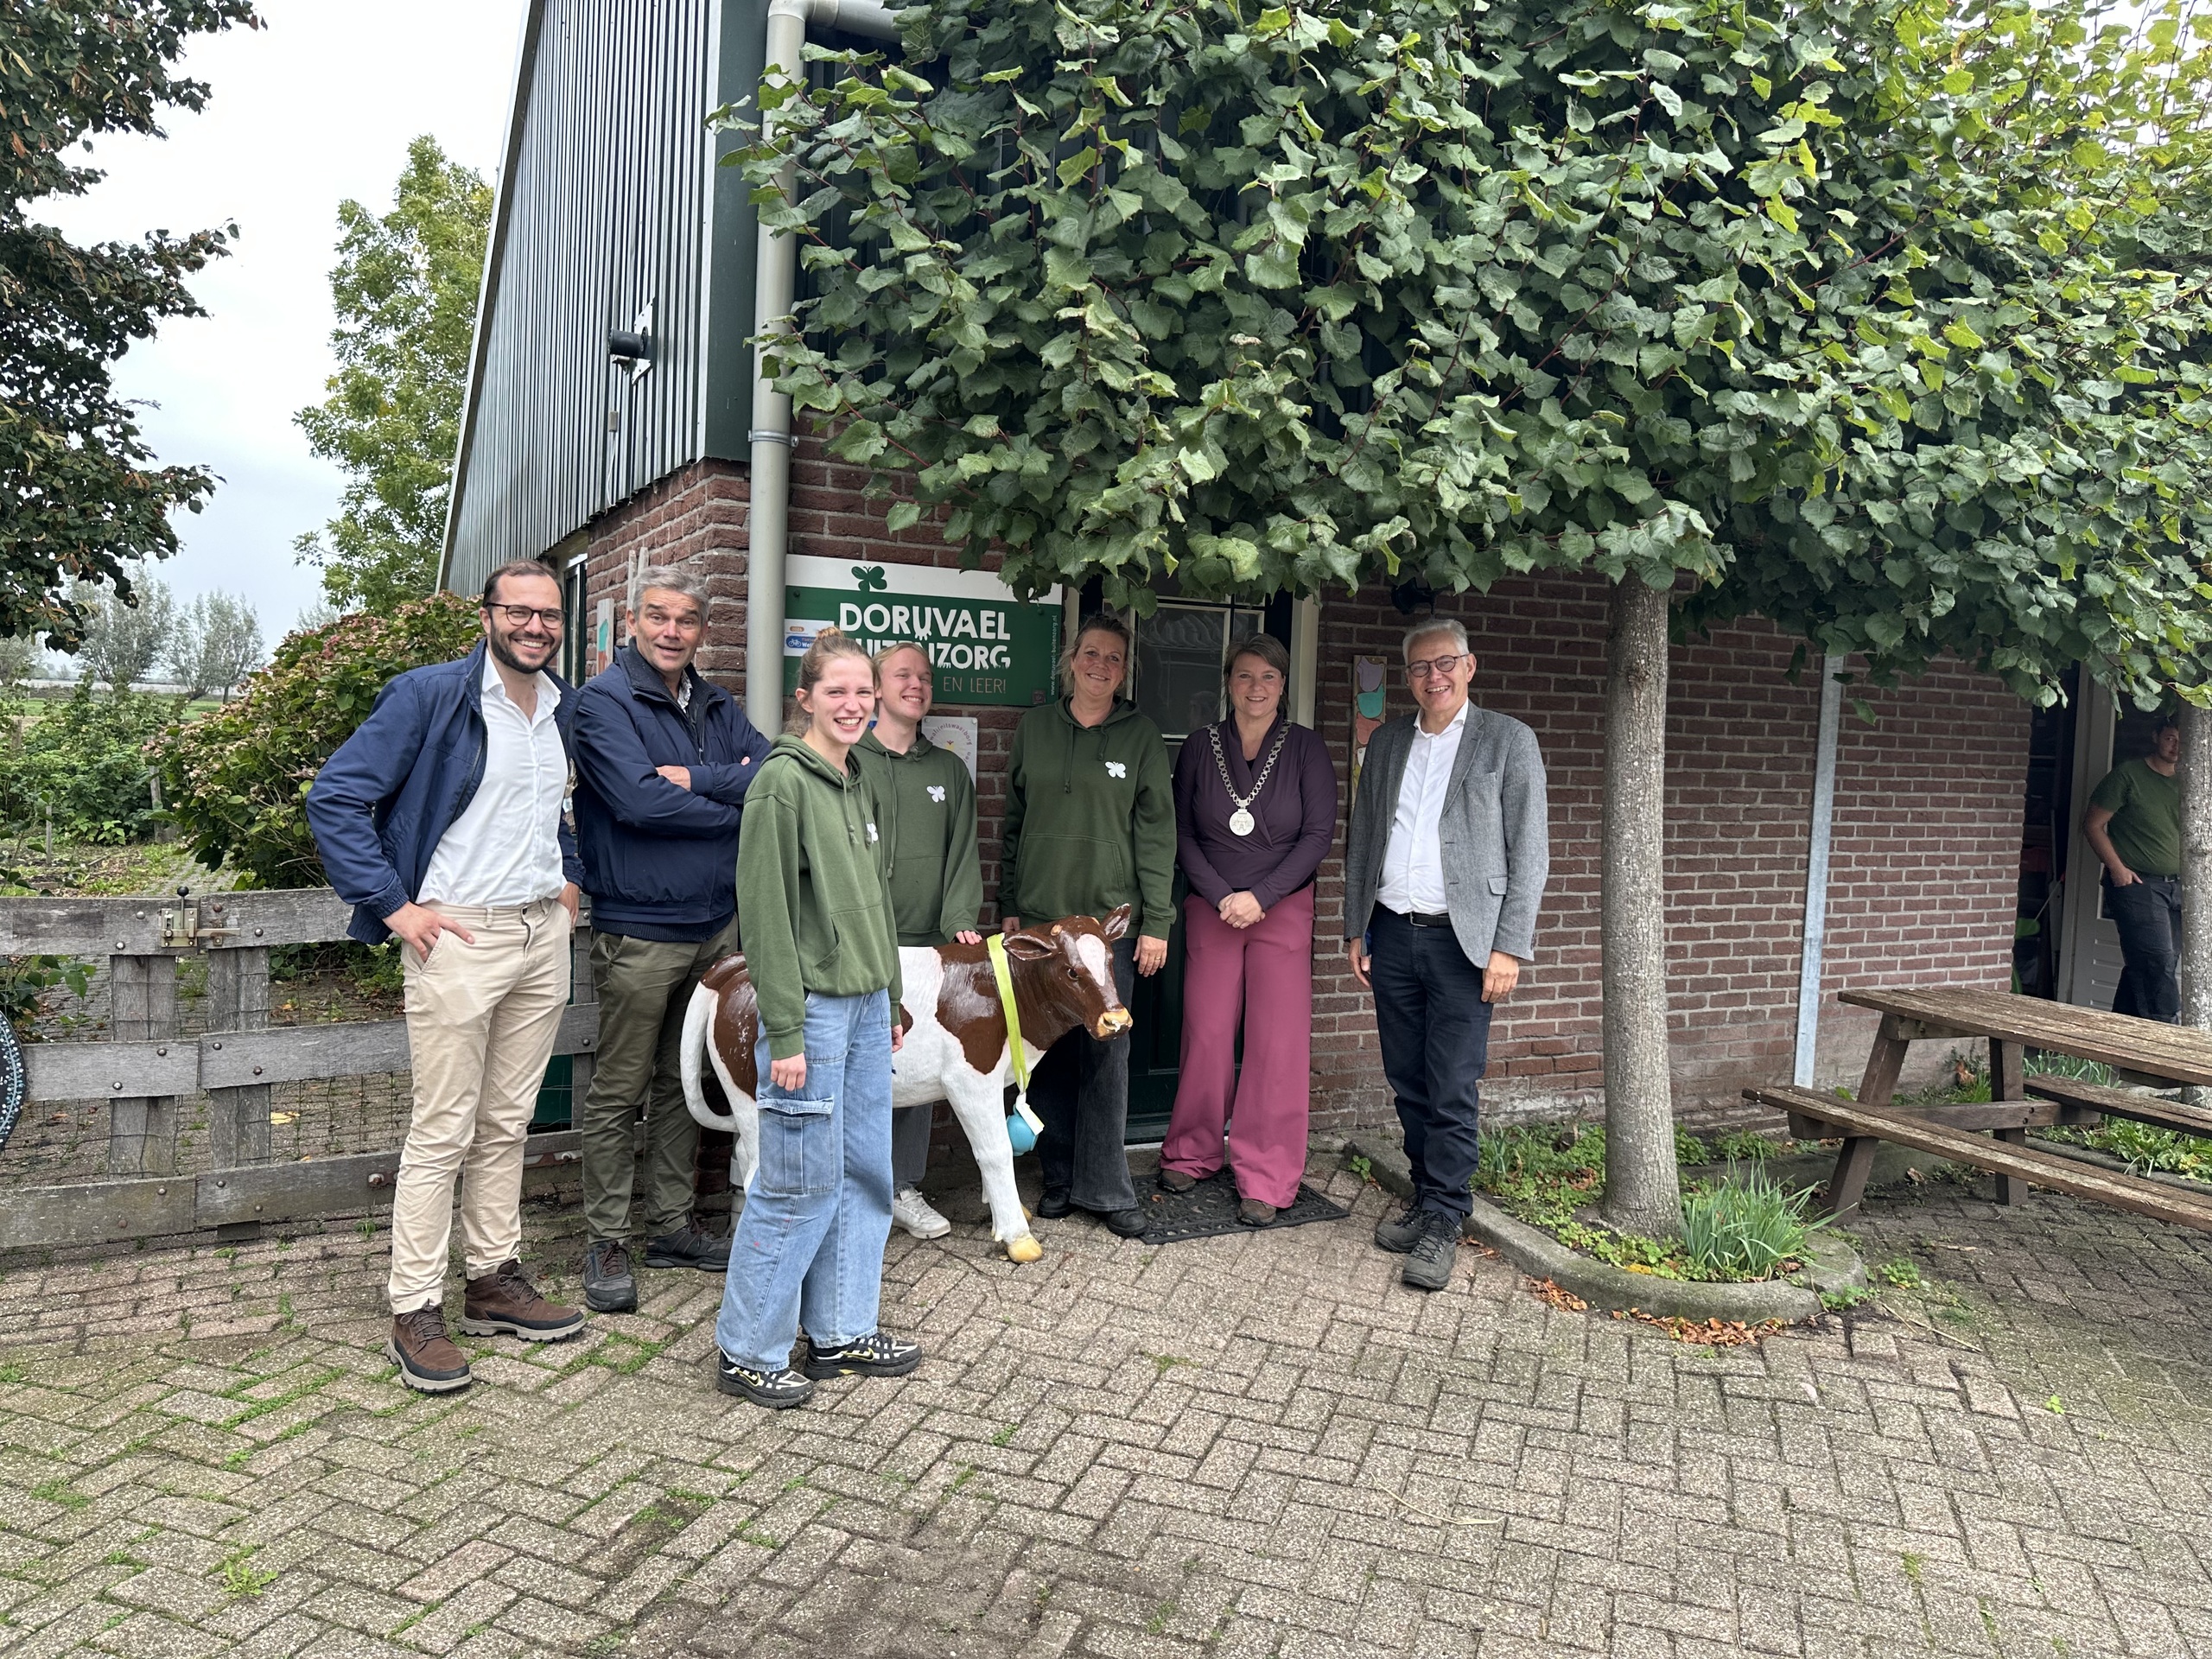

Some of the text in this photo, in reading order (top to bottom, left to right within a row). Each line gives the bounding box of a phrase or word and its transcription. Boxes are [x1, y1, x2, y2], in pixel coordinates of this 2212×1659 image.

[840, 603, 1010, 640] DORUVAEL
[855, 639, 1010, 671] UITNZORG
[944, 677, 1007, 694] EN LEER!
[930, 722, 972, 746] waliteitswaarborg
